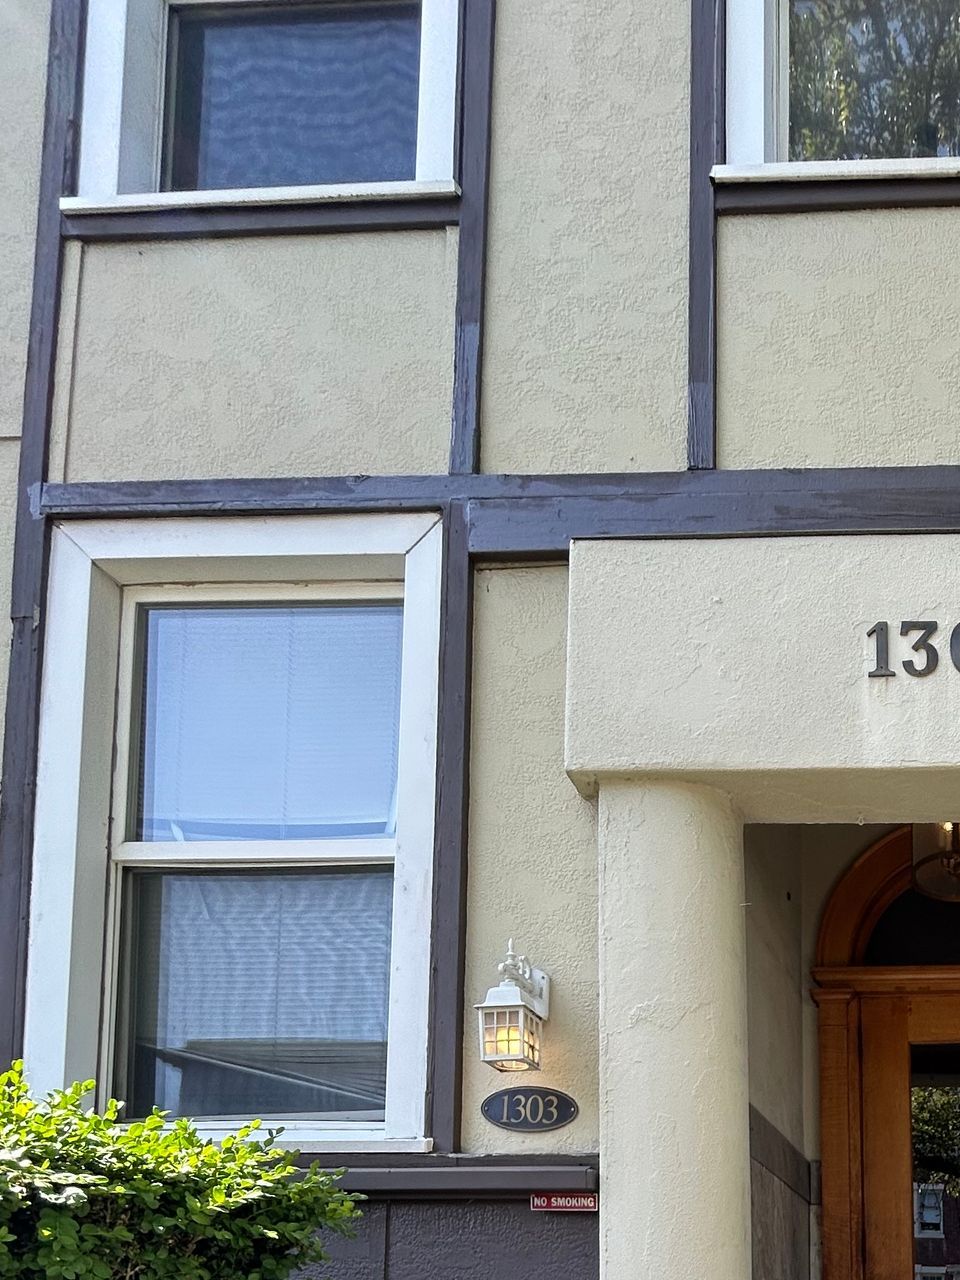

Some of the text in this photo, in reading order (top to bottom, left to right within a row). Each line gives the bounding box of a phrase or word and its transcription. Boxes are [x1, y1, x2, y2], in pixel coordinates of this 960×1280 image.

[500, 1095, 558, 1124] 1303
[533, 1197, 594, 1207] NO SMOKING
